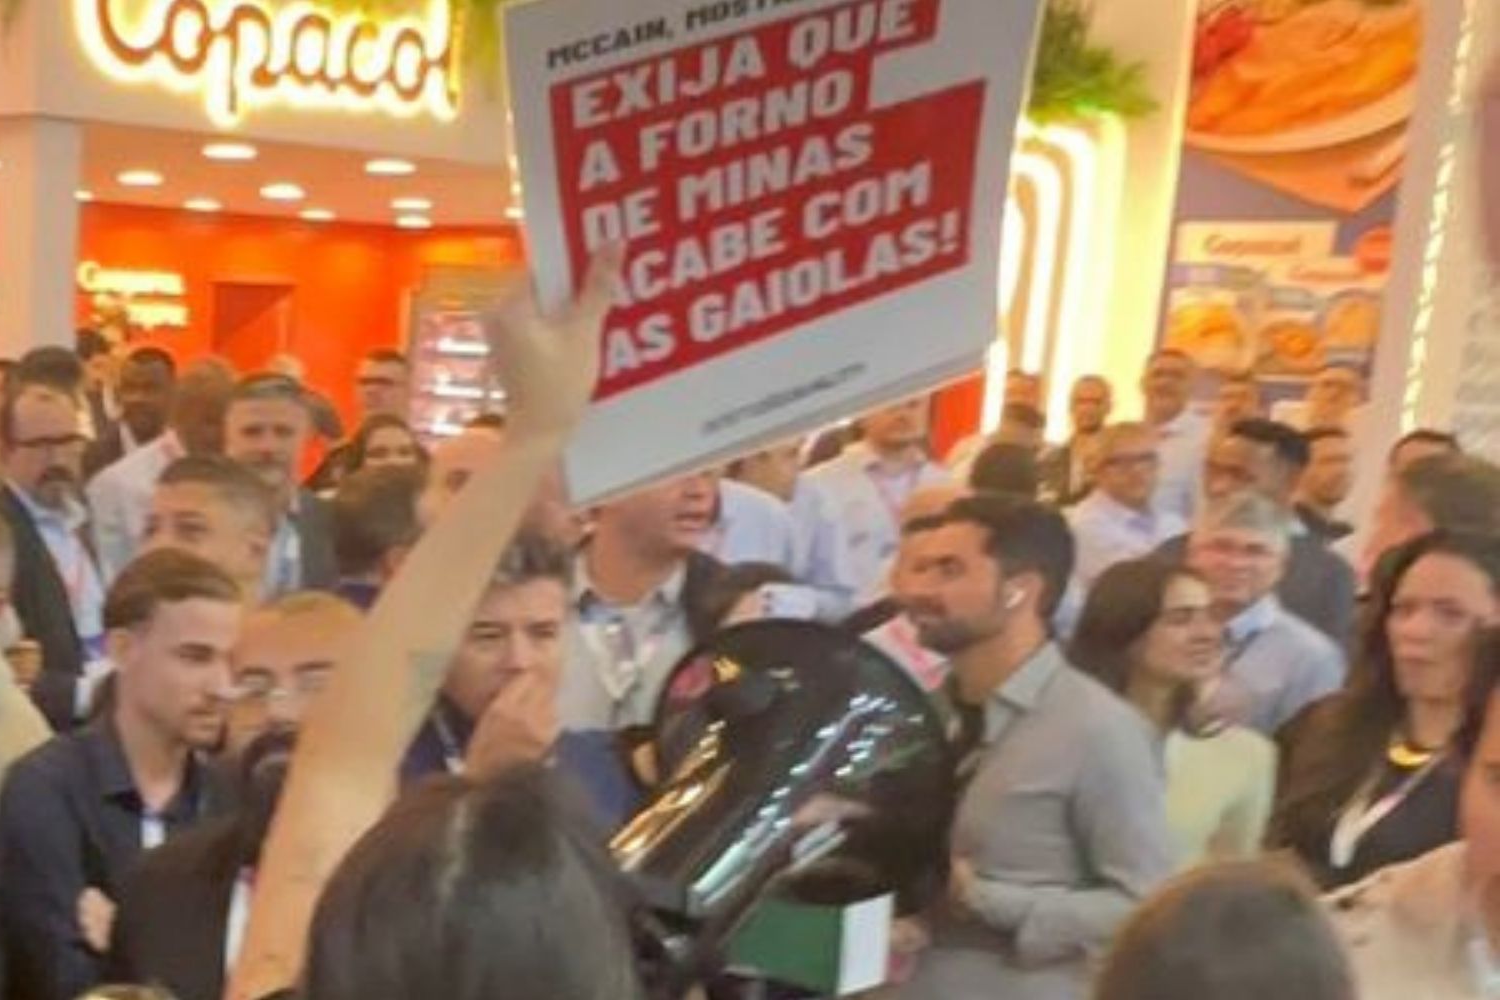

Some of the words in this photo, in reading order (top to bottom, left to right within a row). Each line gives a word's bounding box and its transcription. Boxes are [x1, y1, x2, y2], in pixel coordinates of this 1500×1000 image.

[546, 17, 674, 68] MCCAIN,
[571, 34, 766, 130] EXIJA
[788, 0, 917, 69] QUE
[578, 139, 622, 192] A
[639, 68, 854, 173] FORNO
[582, 186, 661, 254] DE
[677, 122, 874, 223] MINAS
[803, 158, 932, 241] COM
[605, 312, 675, 379] AS
[687, 209, 960, 342] GAIOLAS!
